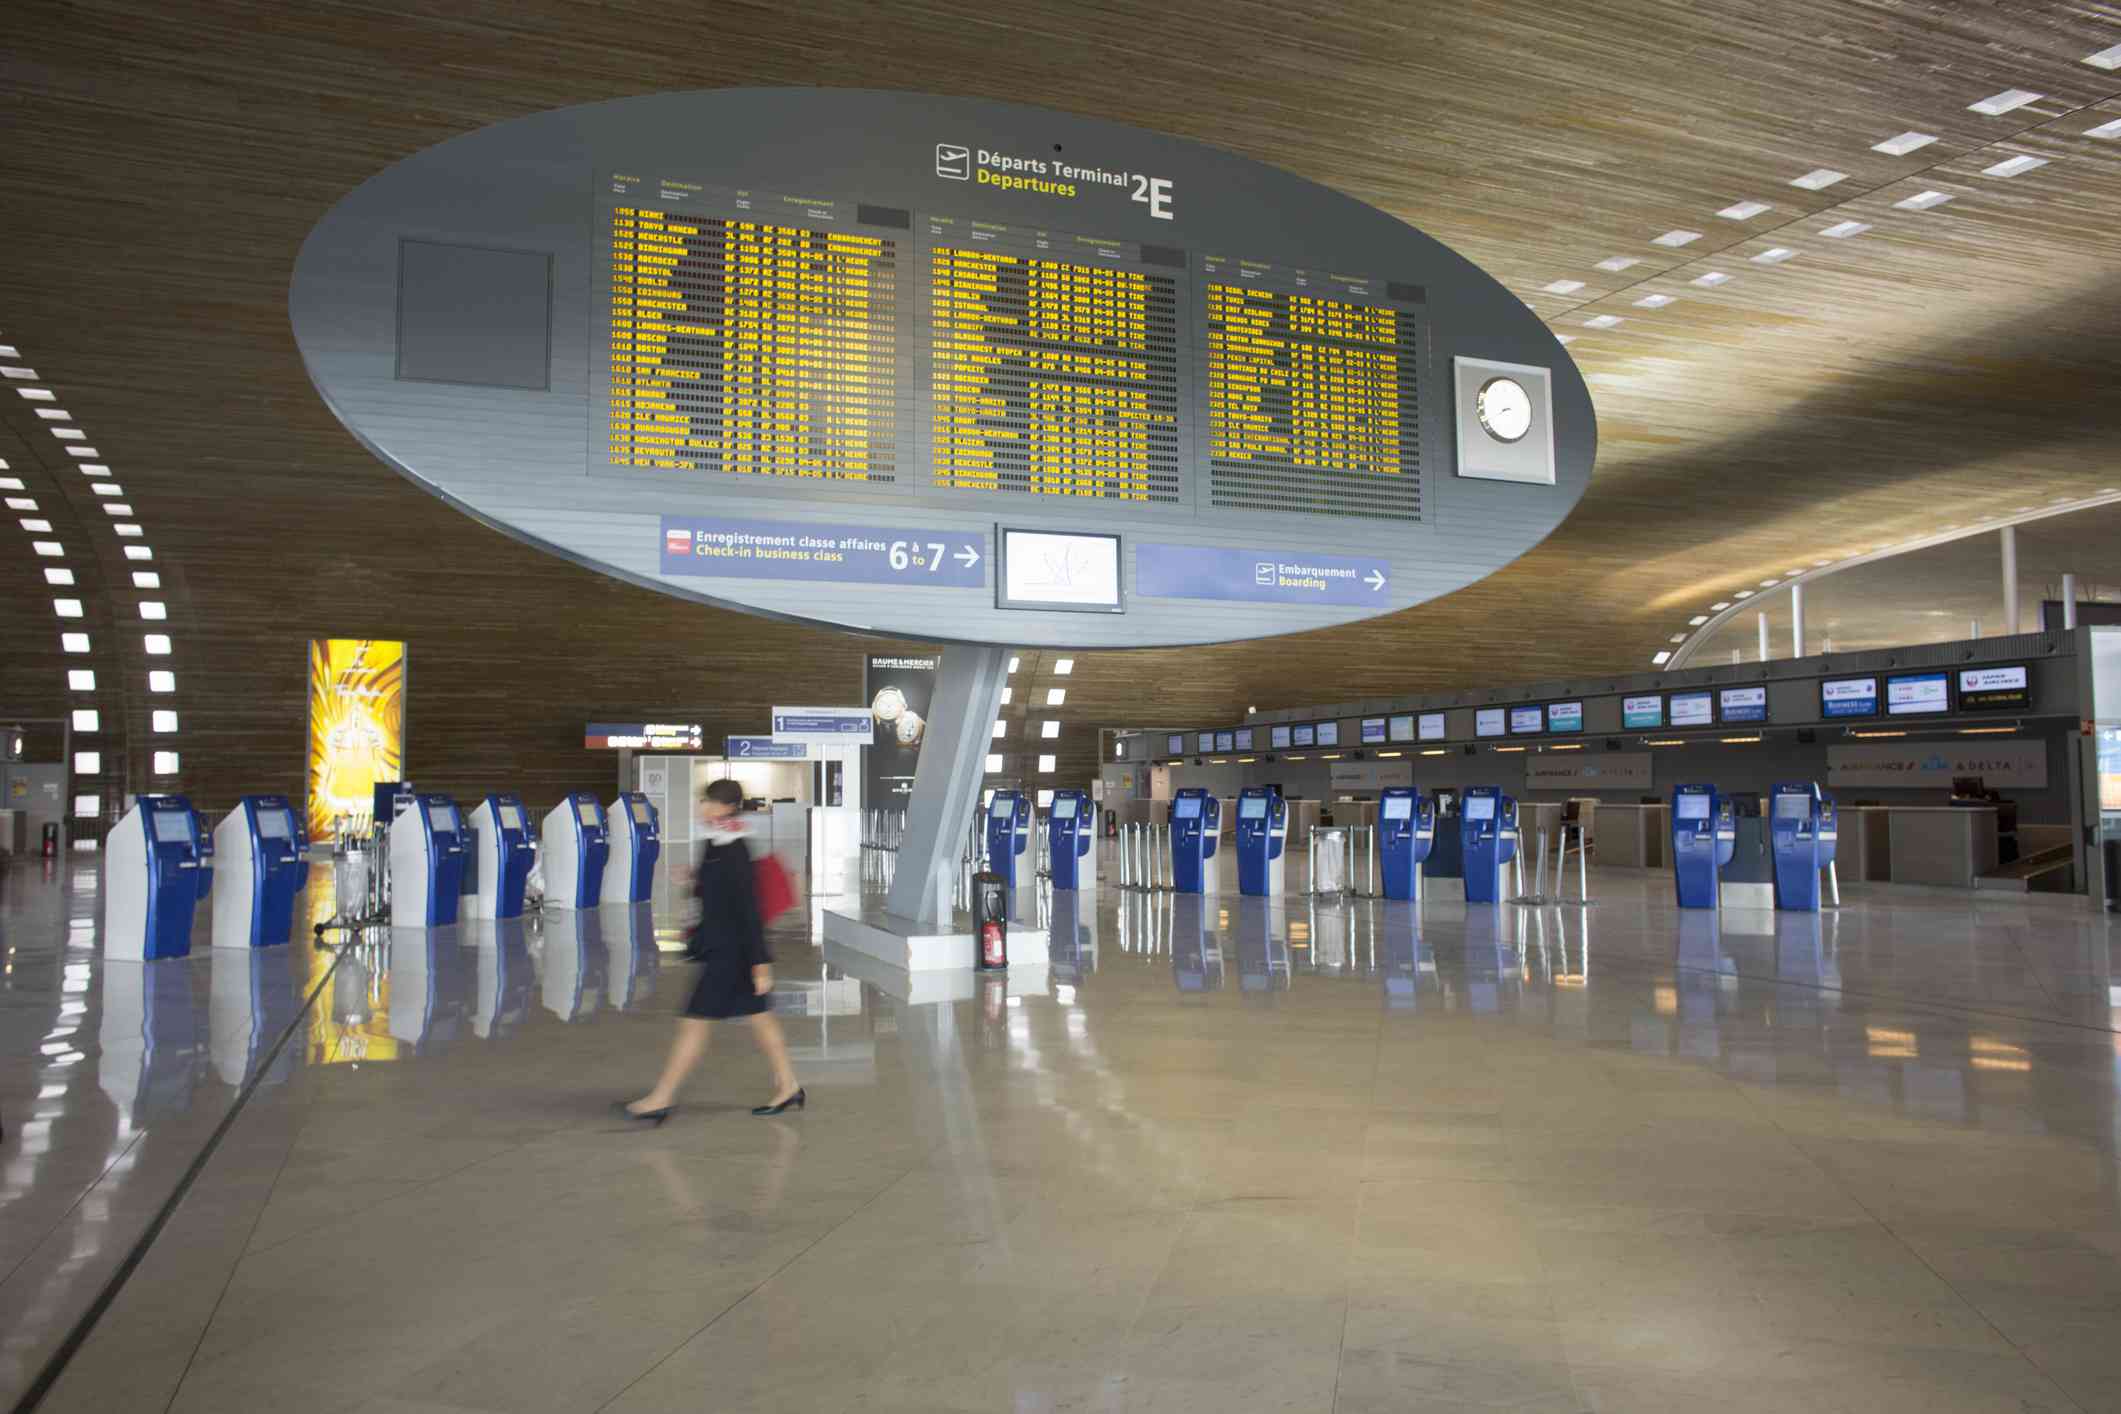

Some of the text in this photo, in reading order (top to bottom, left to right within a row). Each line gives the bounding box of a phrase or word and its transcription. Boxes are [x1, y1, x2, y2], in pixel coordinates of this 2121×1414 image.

[976, 168, 1077, 198] Departures
[977, 149, 1174, 220] Départs Terminal 2E
[696, 530, 886, 552] Enregistrement classe affaires
[696, 545, 844, 562] Check-in business class
[889, 541, 909, 570] 6
[926, 543, 946, 572] 7
[912, 554, 925, 566] to
[1278, 563, 1357, 579] Embarquement
[1279, 576, 1327, 590] Boarding
[776, 717, 784, 731] 1
[740, 741, 751, 756] 2
